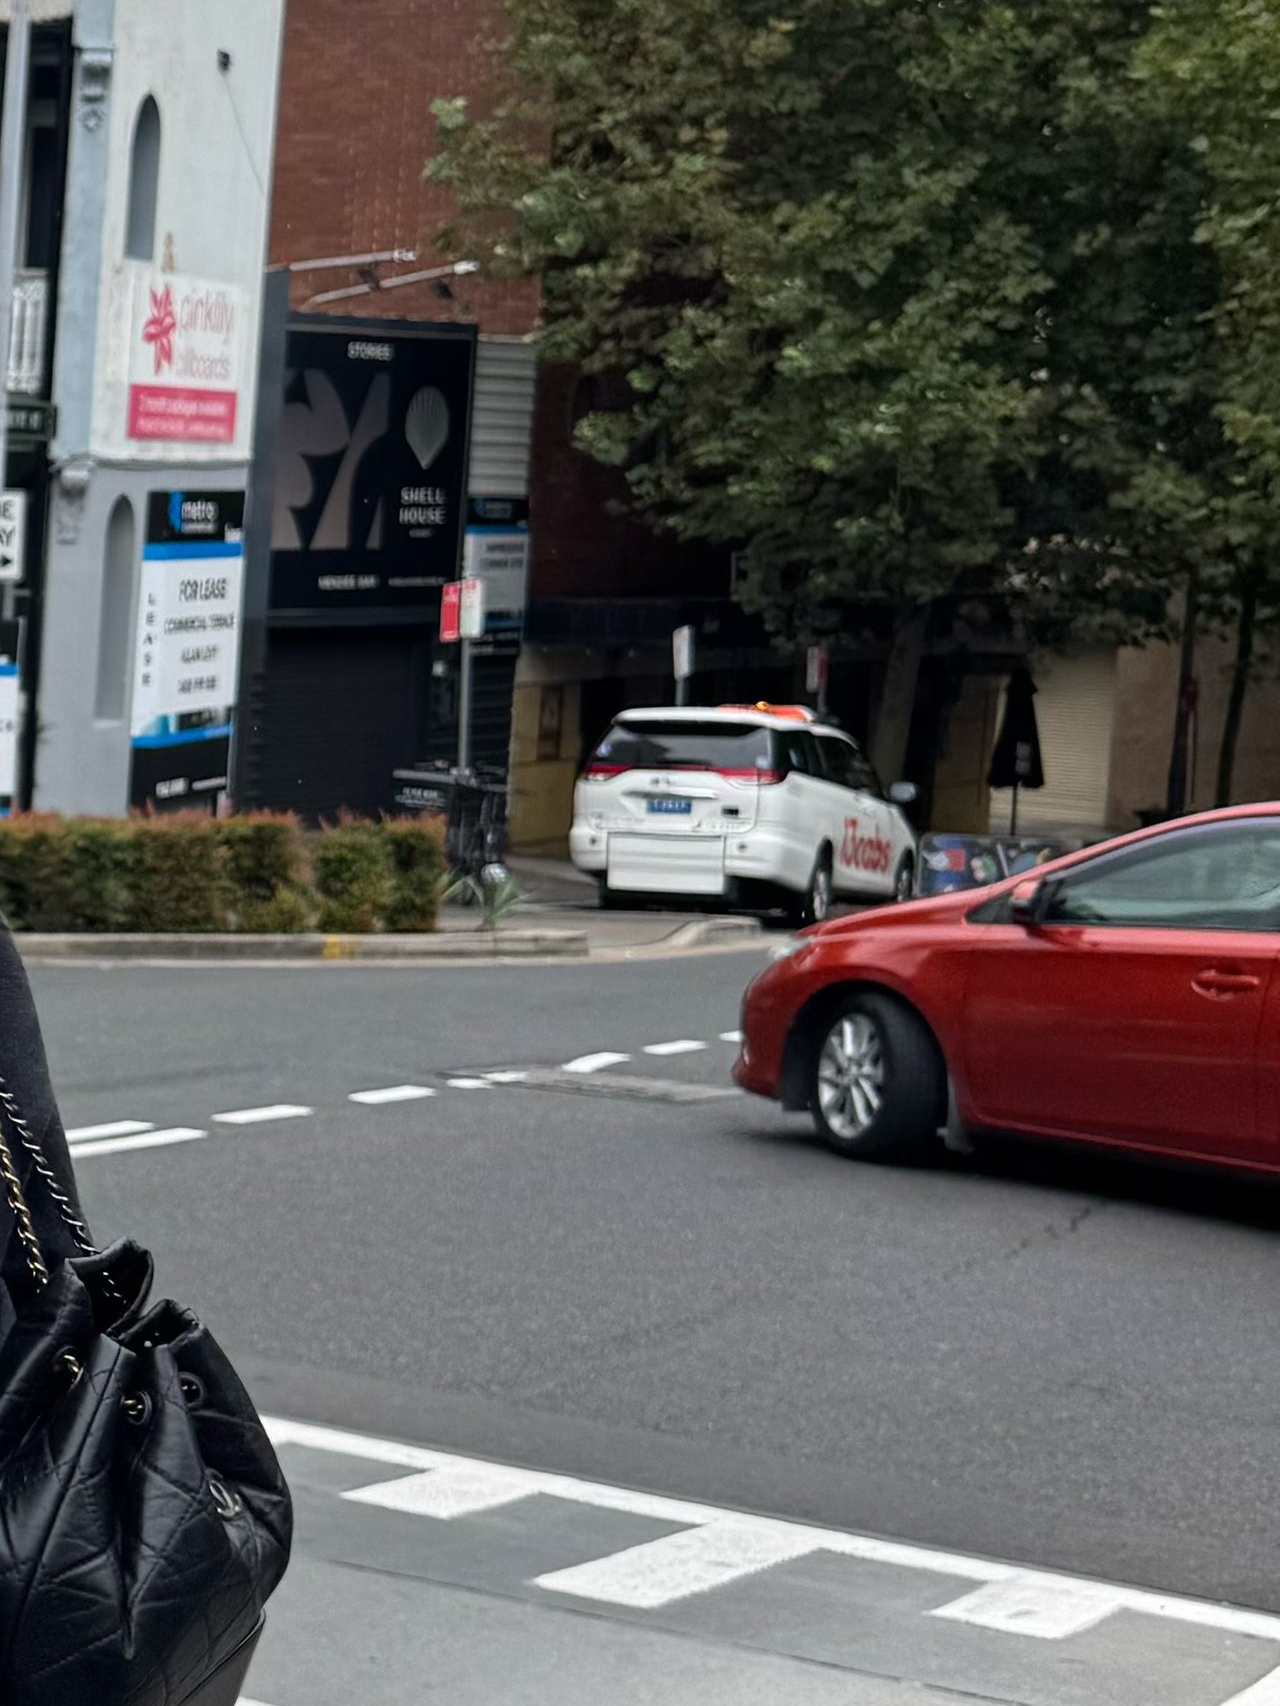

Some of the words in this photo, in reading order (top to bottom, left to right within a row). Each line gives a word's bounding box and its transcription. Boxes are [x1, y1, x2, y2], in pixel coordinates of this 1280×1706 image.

[400, 486, 446, 505] SHELL
[399, 506, 446, 526] HOUSE
[179, 579, 198, 602] FOR
[199, 577, 227, 602] LEASE
